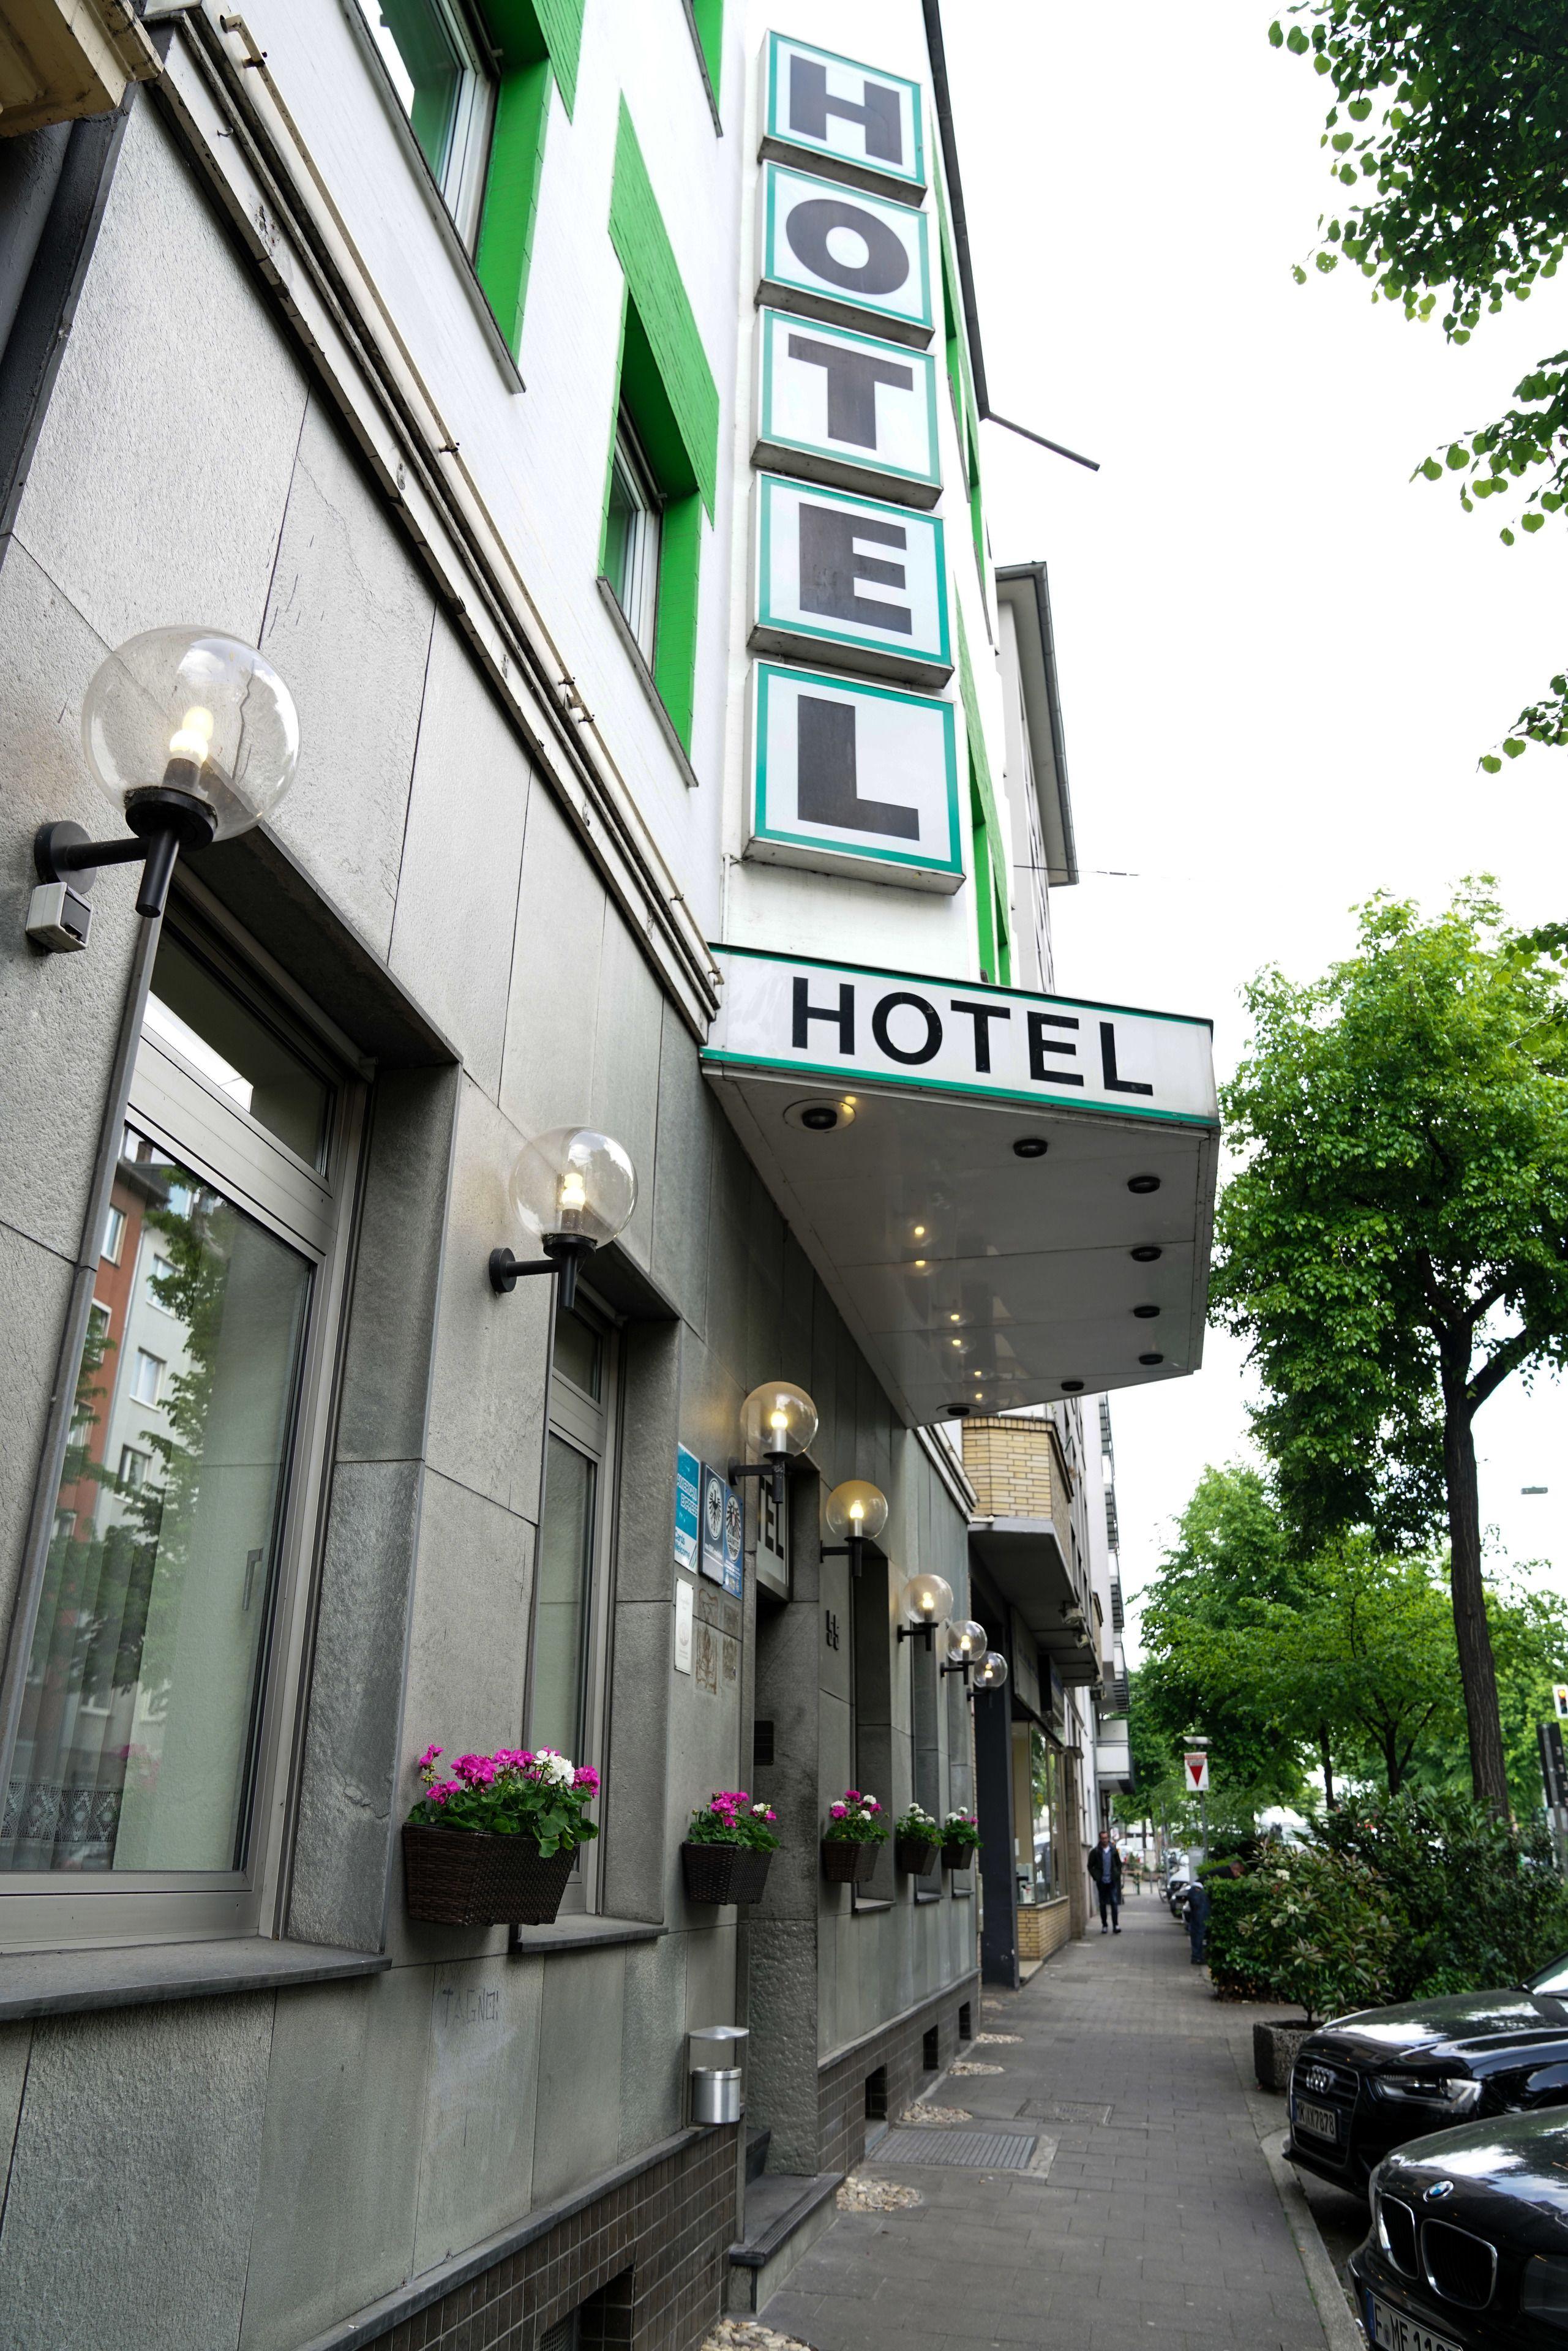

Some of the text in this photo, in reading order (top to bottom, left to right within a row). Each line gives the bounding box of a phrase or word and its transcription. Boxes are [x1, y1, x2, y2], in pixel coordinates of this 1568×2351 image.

[786, 54, 920, 841] HOTEL
[792, 977, 1153, 1096] HOTEL
[677, 1473, 697, 1501] AMERICAN
[680, 1493, 697, 1518] EXPRESS
